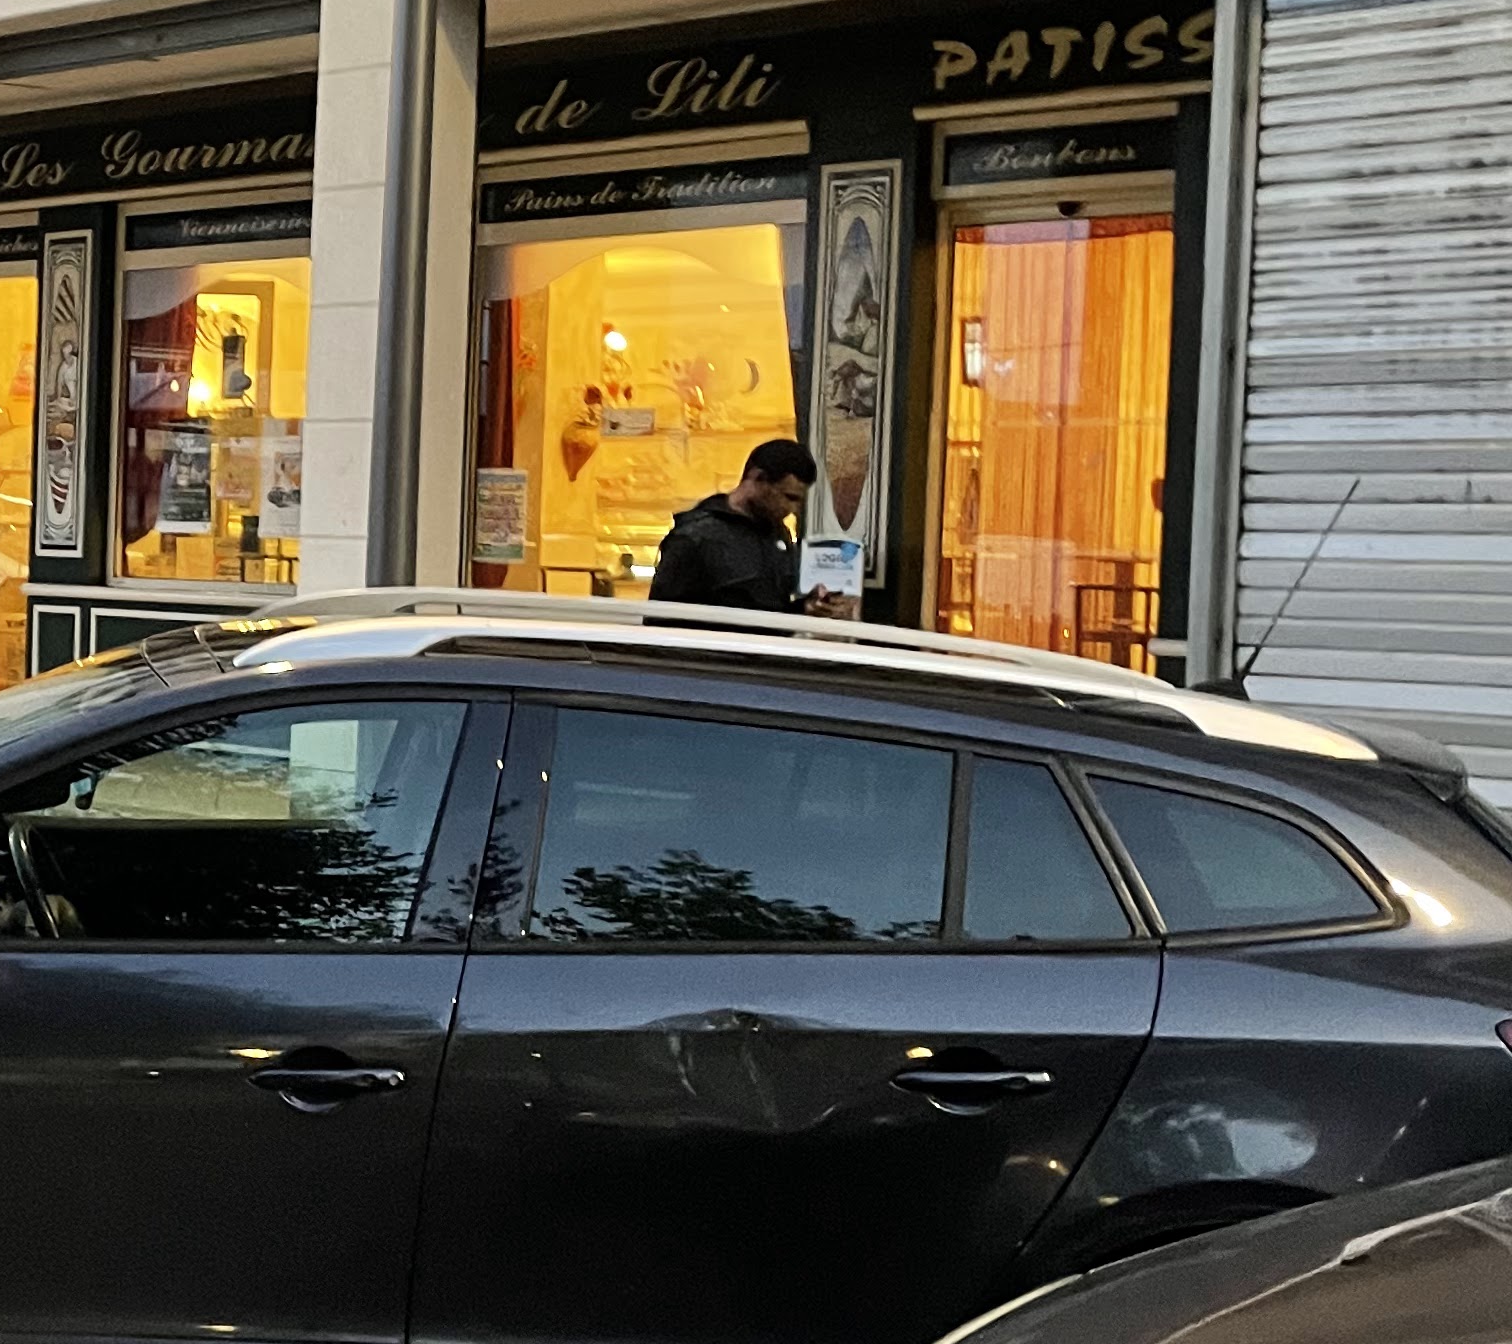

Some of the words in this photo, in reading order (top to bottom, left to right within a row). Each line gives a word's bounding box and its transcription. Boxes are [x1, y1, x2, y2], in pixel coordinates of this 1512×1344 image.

[515, 79, 600, 135] de
[632, 54, 781, 121] Lili
[504, 188, 584, 213] Pains
[590, 180, 622, 205] de
